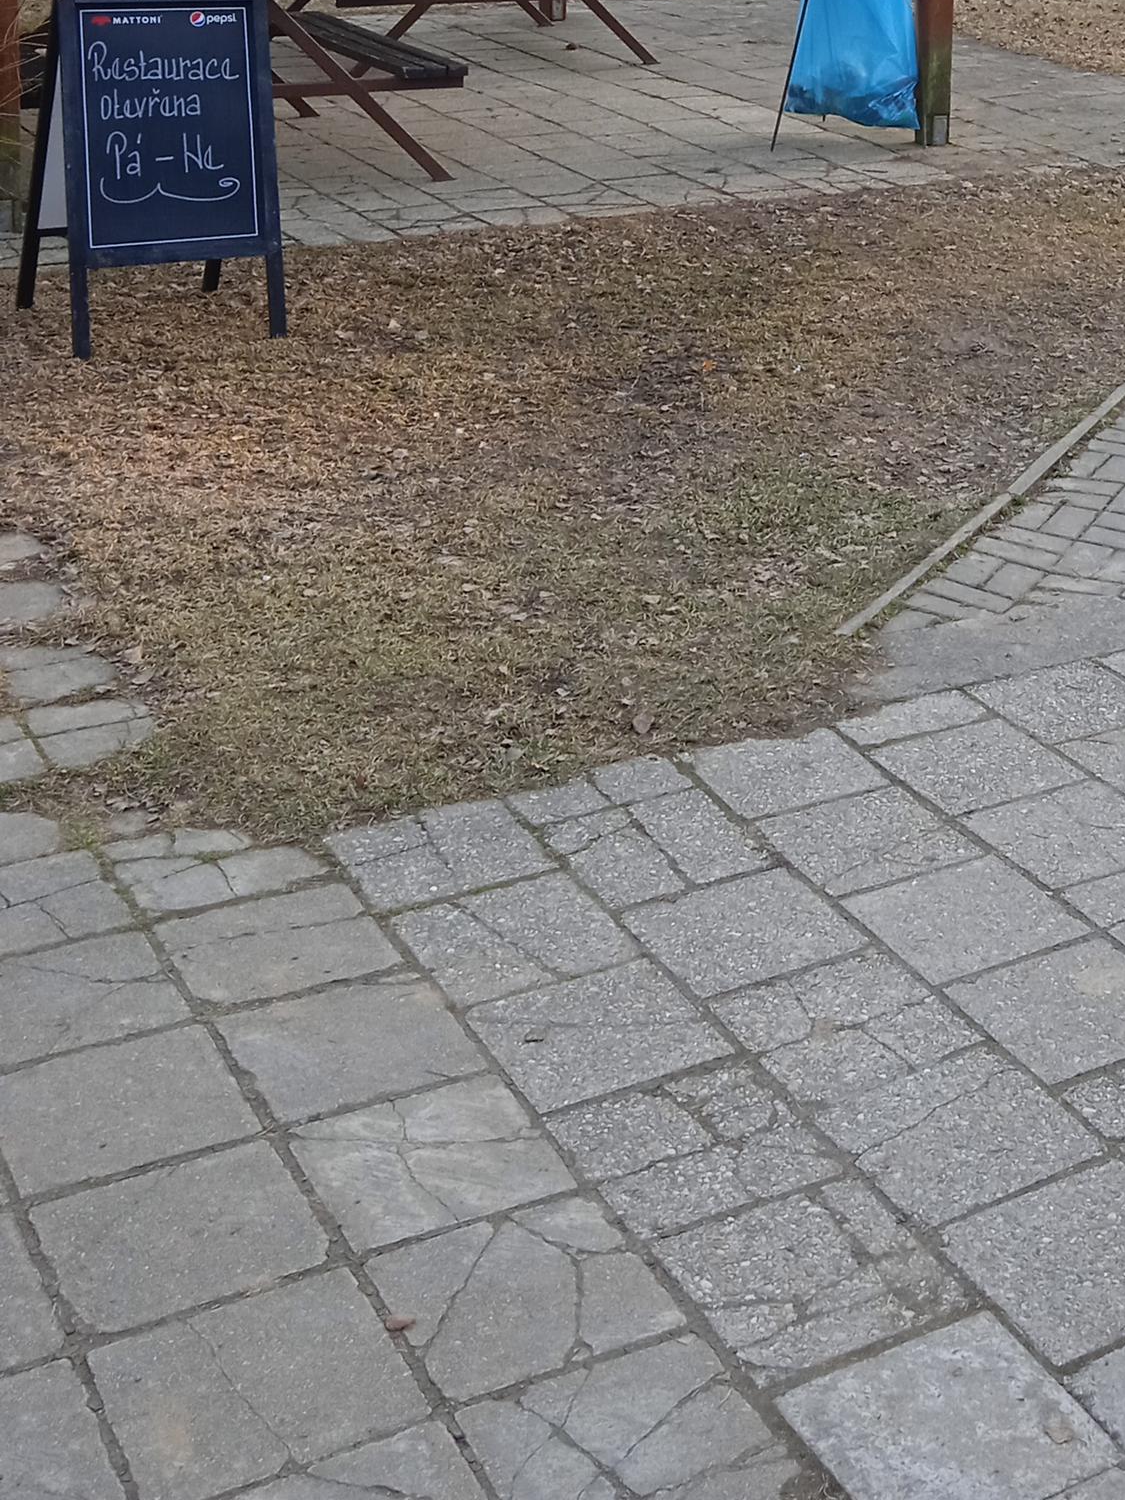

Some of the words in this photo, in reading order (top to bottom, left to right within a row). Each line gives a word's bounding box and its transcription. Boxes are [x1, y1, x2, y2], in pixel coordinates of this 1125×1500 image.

[112, 15, 161, 25] MATTONI
[206, 13, 237, 25] pepsi
[88, 40, 240, 82] Restaurace
[106, 131, 142, 180] Pá
[183, 132, 224, 173] Ne
